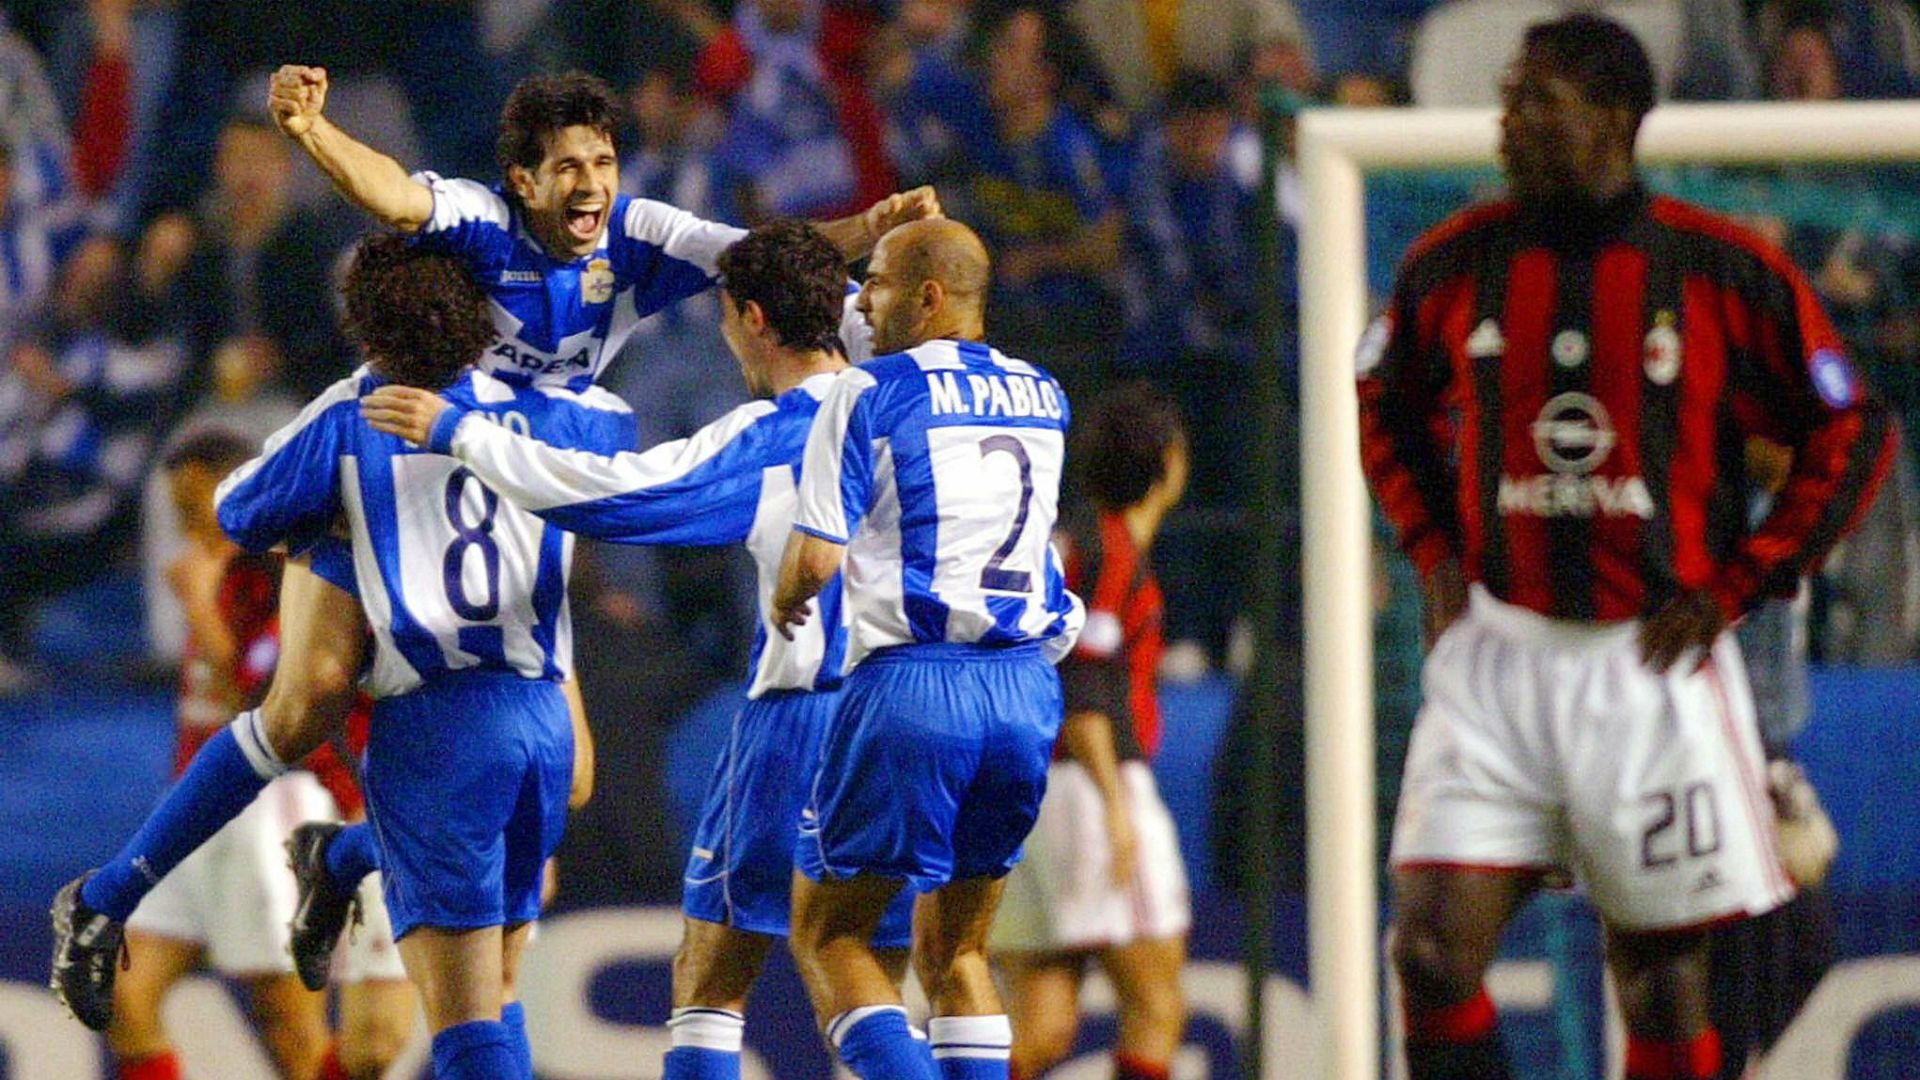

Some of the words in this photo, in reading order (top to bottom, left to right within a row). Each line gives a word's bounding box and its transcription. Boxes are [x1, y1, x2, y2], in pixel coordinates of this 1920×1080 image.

[443, 465, 499, 622] 8
[979, 434, 1034, 593] 2
[1641, 782, 1721, 870] 20
